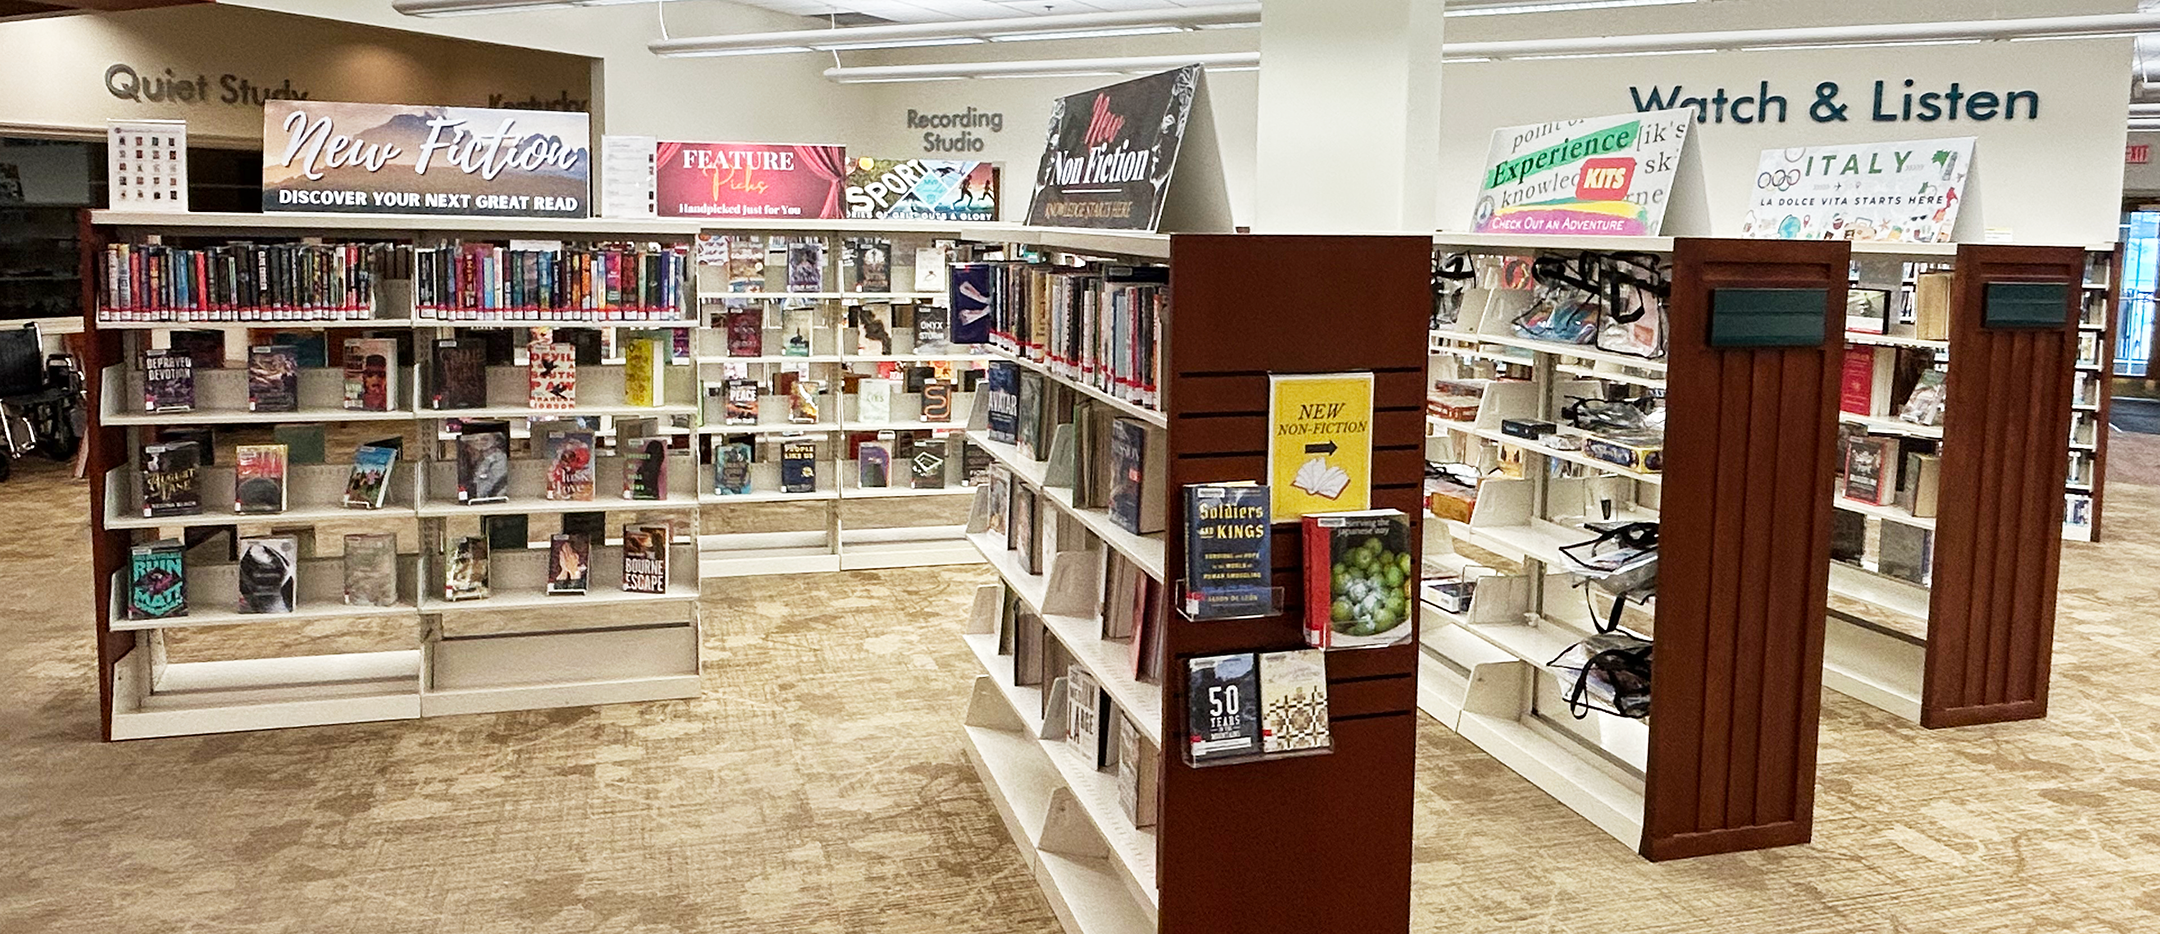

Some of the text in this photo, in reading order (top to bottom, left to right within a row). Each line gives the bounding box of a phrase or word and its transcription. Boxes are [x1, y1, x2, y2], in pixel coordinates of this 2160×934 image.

[105, 63, 309, 106] Quiet Study
[1630, 79, 2039, 124] Watch & Listen
[907, 106, 1004, 133] Recording
[283, 110, 579, 181] New Fiction
[923, 131, 985, 152] Studio
[683, 149, 795, 171] FEATURE
[1049, 138, 1150, 186] Non Fiction
[1490, 128, 1630, 189] Experience
[1804, 150, 1913, 177] ITALY
[703, 164, 769, 202] Picks
[1583, 168, 1626, 189] KITS
[279, 190, 578, 212] DISCOVER YOUR NEXT GREAT READ
[679, 203, 741, 215] Handpicked
[764, 204, 779, 215] for
[780, 205, 802, 215] You
[1760, 195, 1944, 206] LA DOLCE VITA STARTS HERE
[960, 212, 992, 220] GLORY
[920, 321, 943, 329] ONYX
[919, 331, 944, 340] STORM
[531, 353, 574, 362] DEVIL
[149, 368, 190, 380] DEVOTION
[730, 390, 757, 401] PEACE
[990, 391, 1017, 417] AVATAR
[1298, 402, 1346, 420] NEW
[1278, 420, 1368, 437] NON-FICTION
[1199, 503, 1264, 520] Soldiers
[1217, 524, 1264, 540] KINGS
[133, 559, 182, 582] RUIN
[625, 558, 664, 575] BOURNE
[625, 573, 664, 592] ESCAPE
[1208, 684, 1240, 717] 50
[1210, 715, 1241, 728] YEARS
